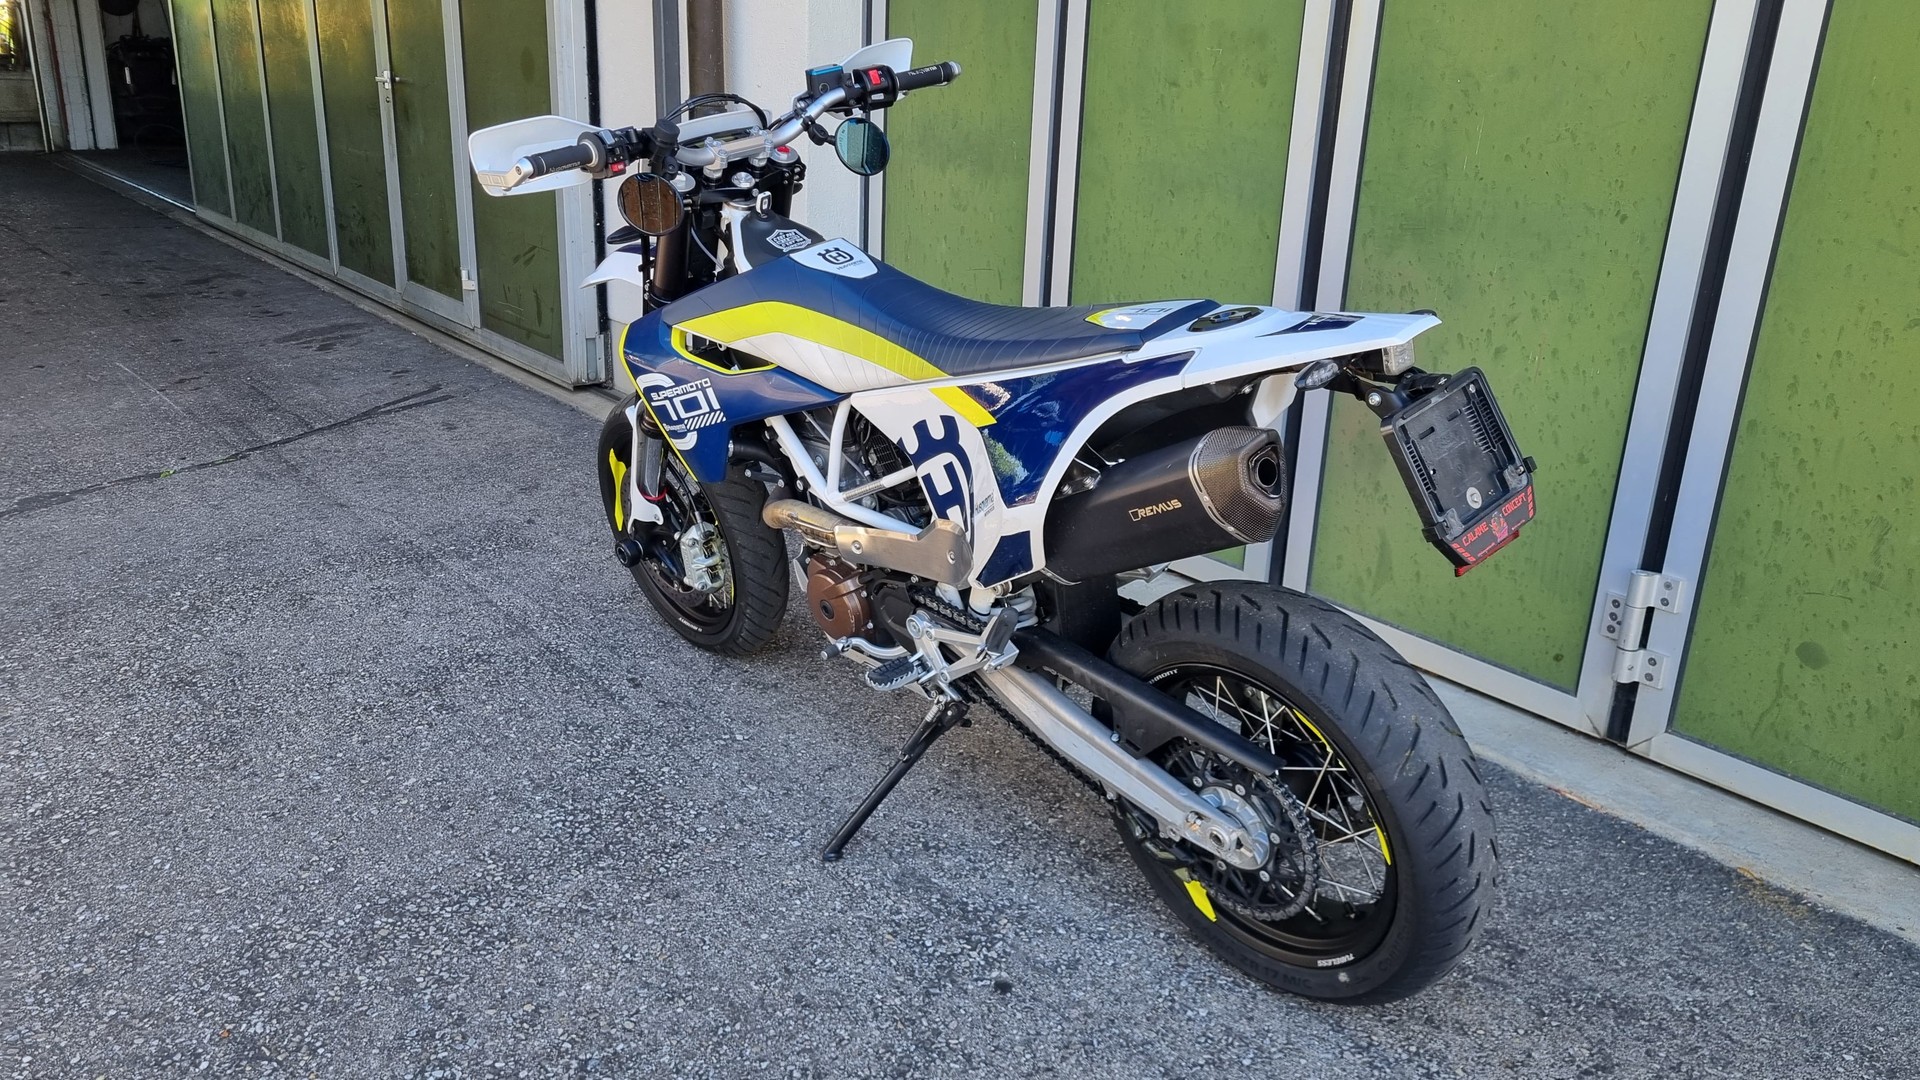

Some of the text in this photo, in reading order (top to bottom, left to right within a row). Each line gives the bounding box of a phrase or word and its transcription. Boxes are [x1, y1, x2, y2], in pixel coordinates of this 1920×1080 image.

[650, 378, 711, 400] SUPERMOTO
[650, 387, 721, 420] 701
[1130, 499, 1182, 519] REMUS
[1502, 492, 1526, 516] CONCEPT
[1317, 953, 1355, 968] TUBELESS
